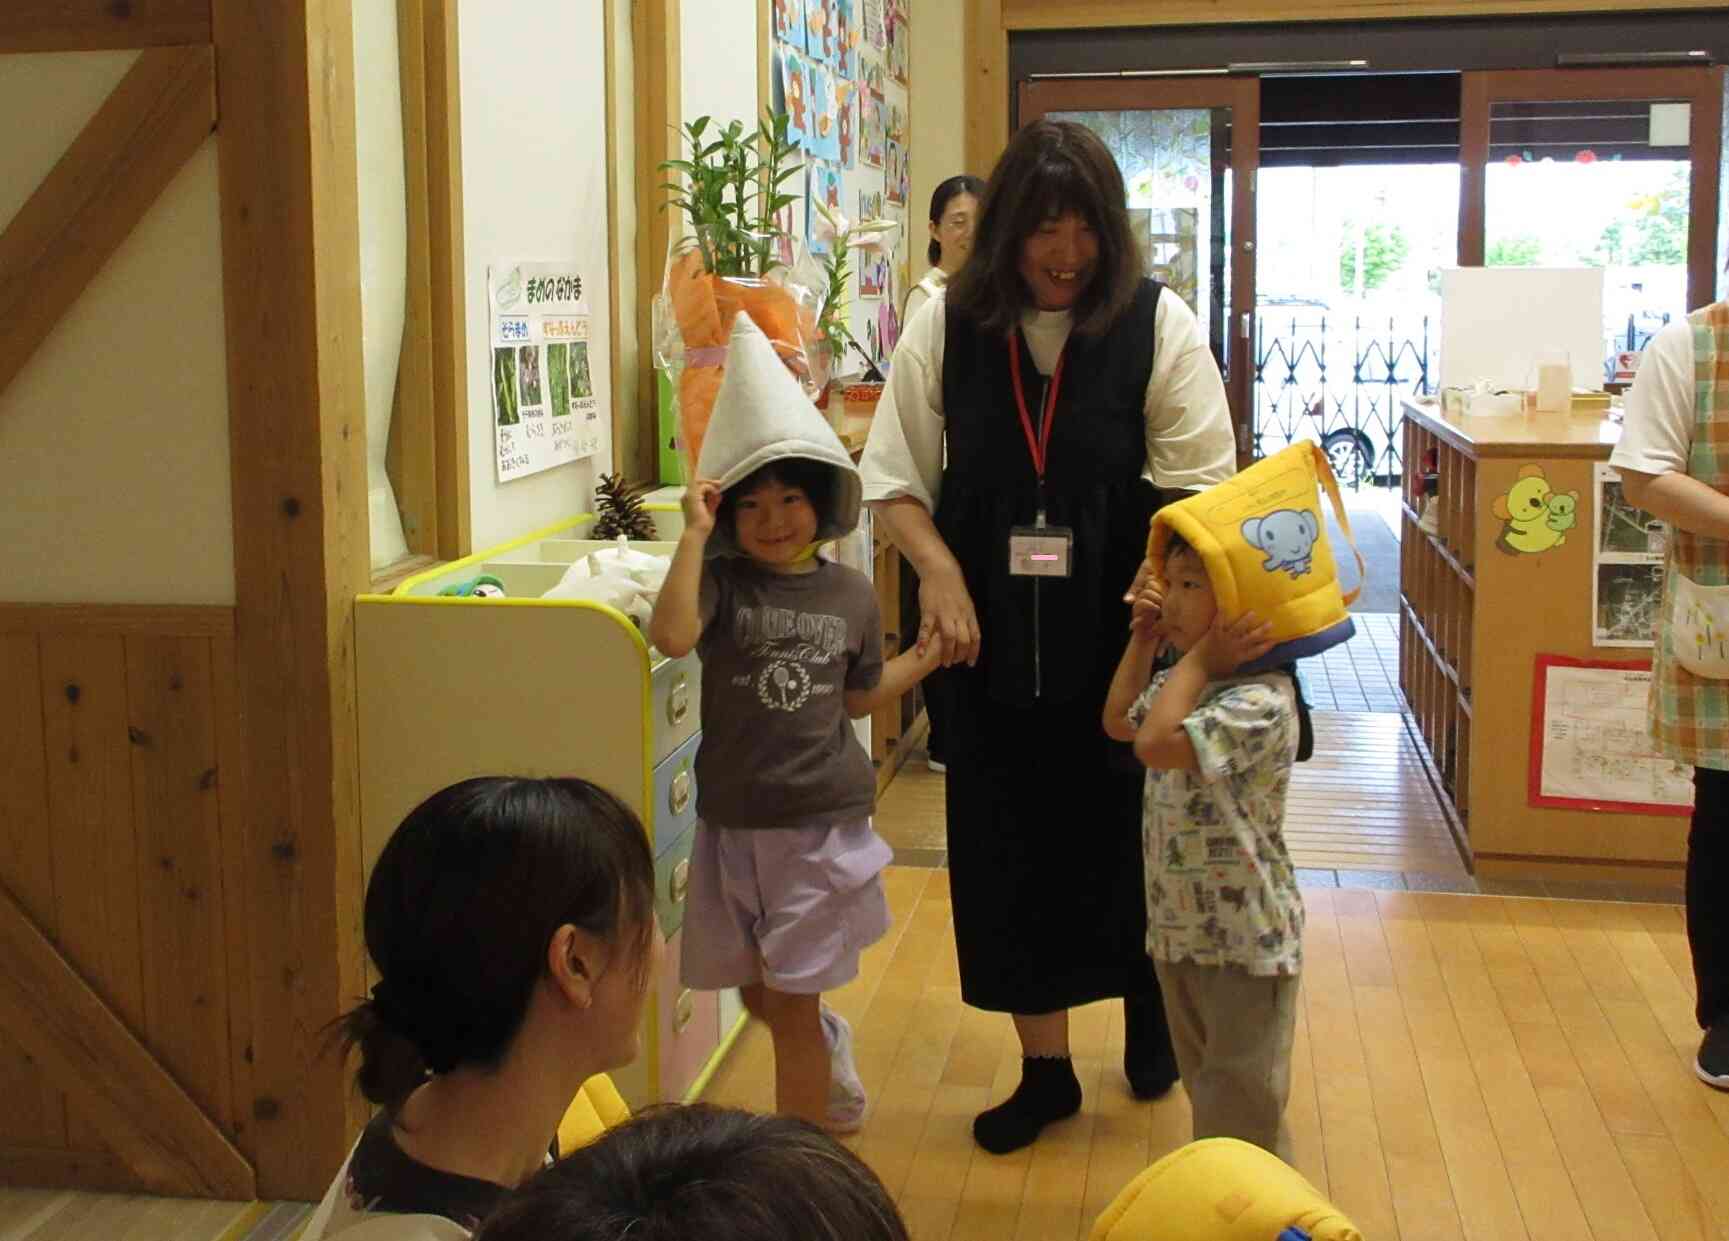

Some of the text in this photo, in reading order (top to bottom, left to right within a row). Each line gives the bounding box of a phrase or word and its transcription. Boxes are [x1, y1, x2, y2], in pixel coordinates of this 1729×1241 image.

[527, 275, 582, 304] まめのなかま
[501, 321, 528, 338] そらまめ
[798, 643, 831, 664] Club
